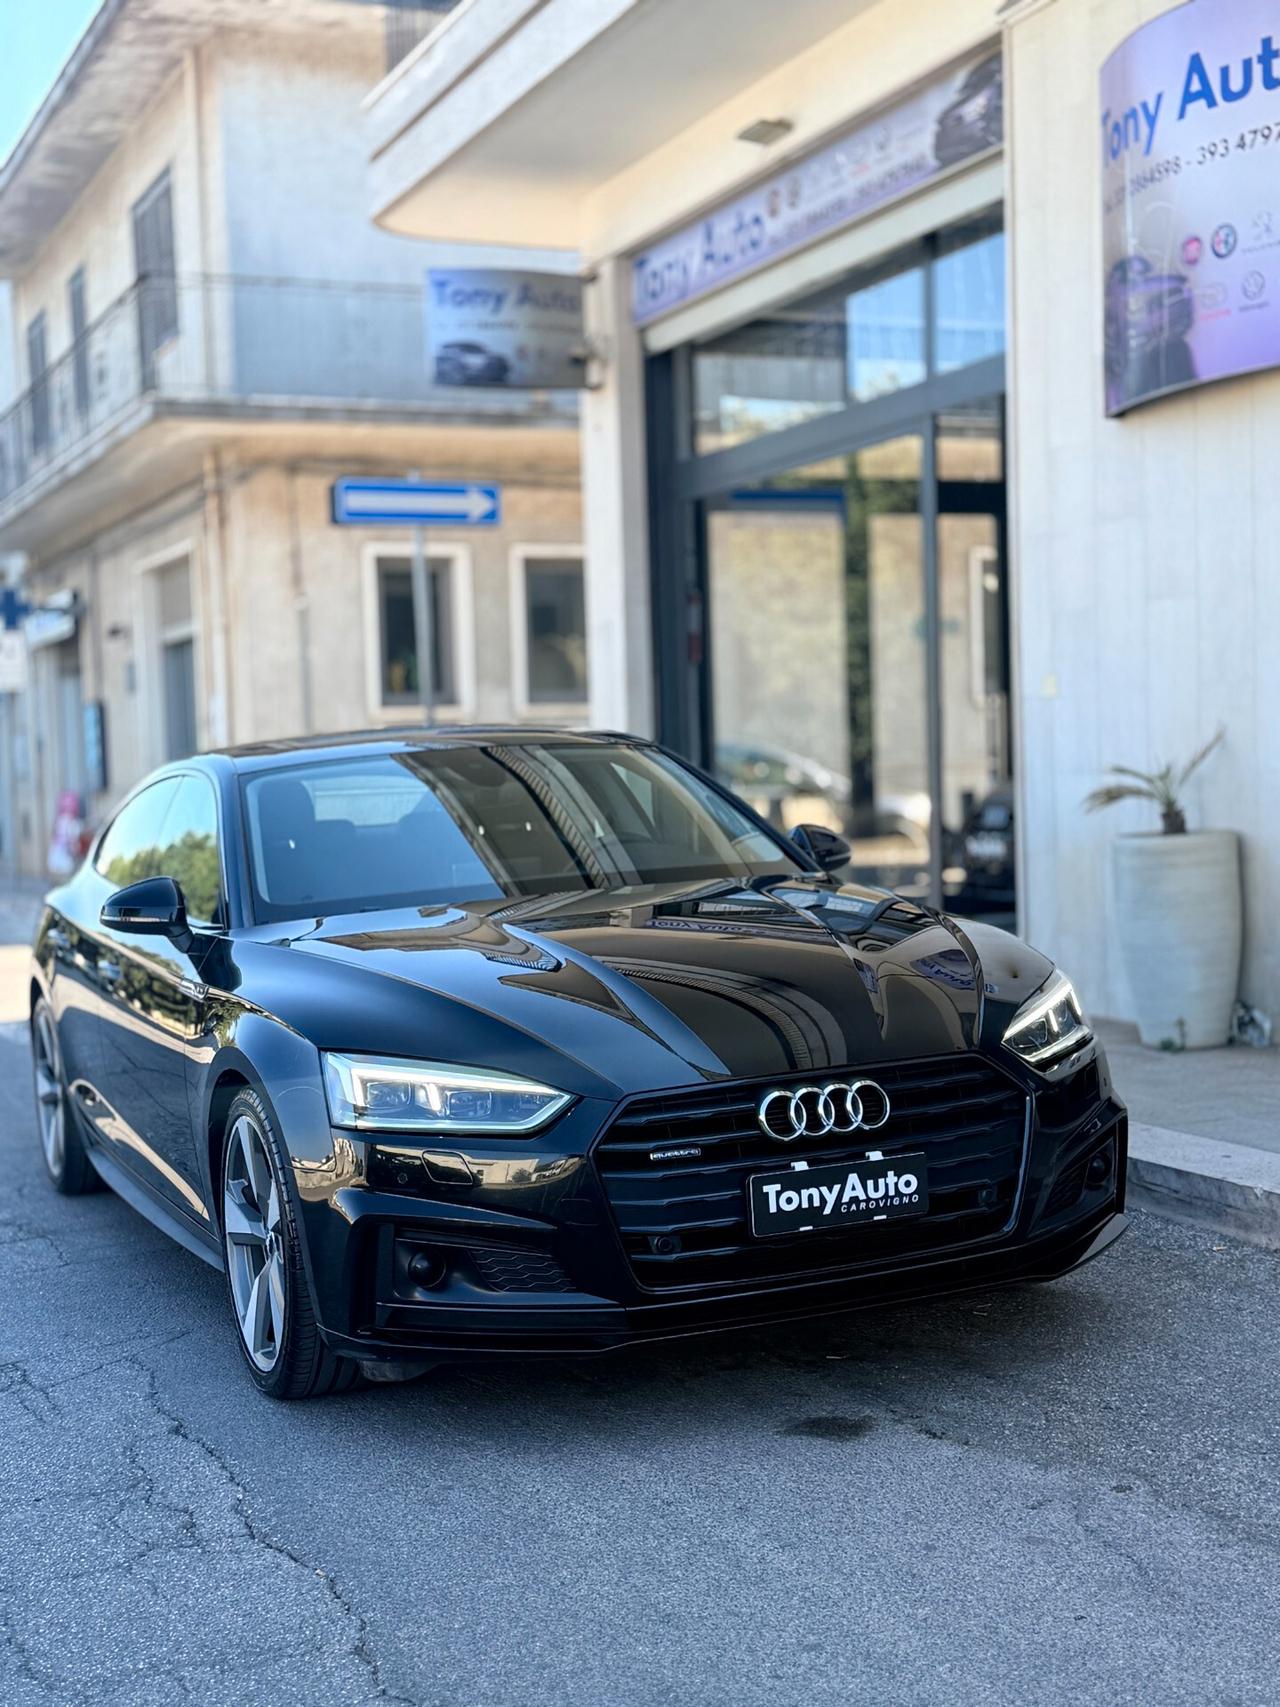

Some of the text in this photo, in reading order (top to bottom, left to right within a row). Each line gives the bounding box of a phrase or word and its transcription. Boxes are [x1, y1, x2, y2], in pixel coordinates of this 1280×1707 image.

[1196, 137, 1230, 166] 393
[433, 280, 510, 315] Tony
[840, 1194, 919, 1213] CAROVIGNO
